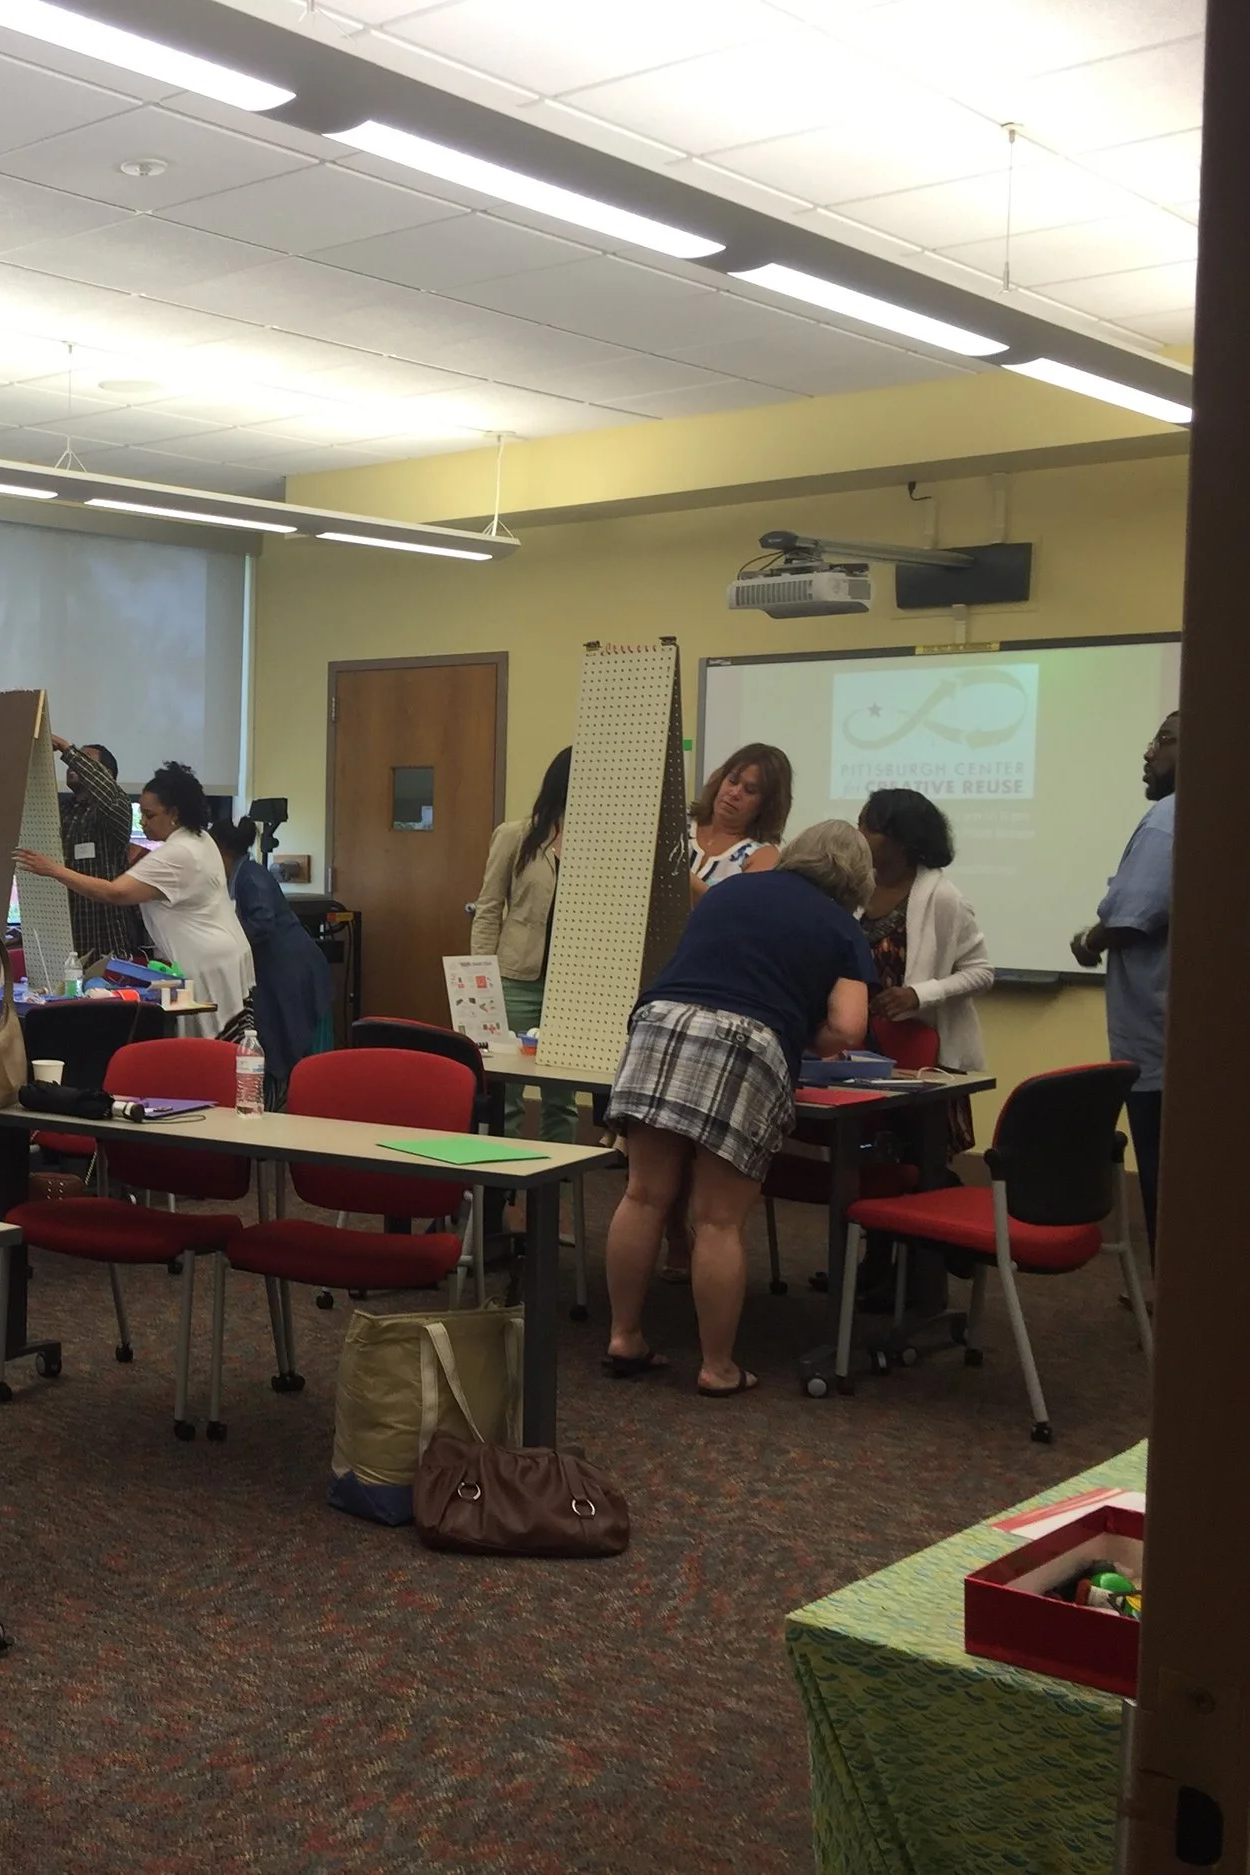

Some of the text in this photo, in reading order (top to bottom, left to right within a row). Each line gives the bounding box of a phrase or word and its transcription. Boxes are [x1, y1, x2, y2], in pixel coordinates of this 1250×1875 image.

[840, 761, 1025, 777] PITTSBURGH CENTER
[962, 779, 1025, 794] REUSE
